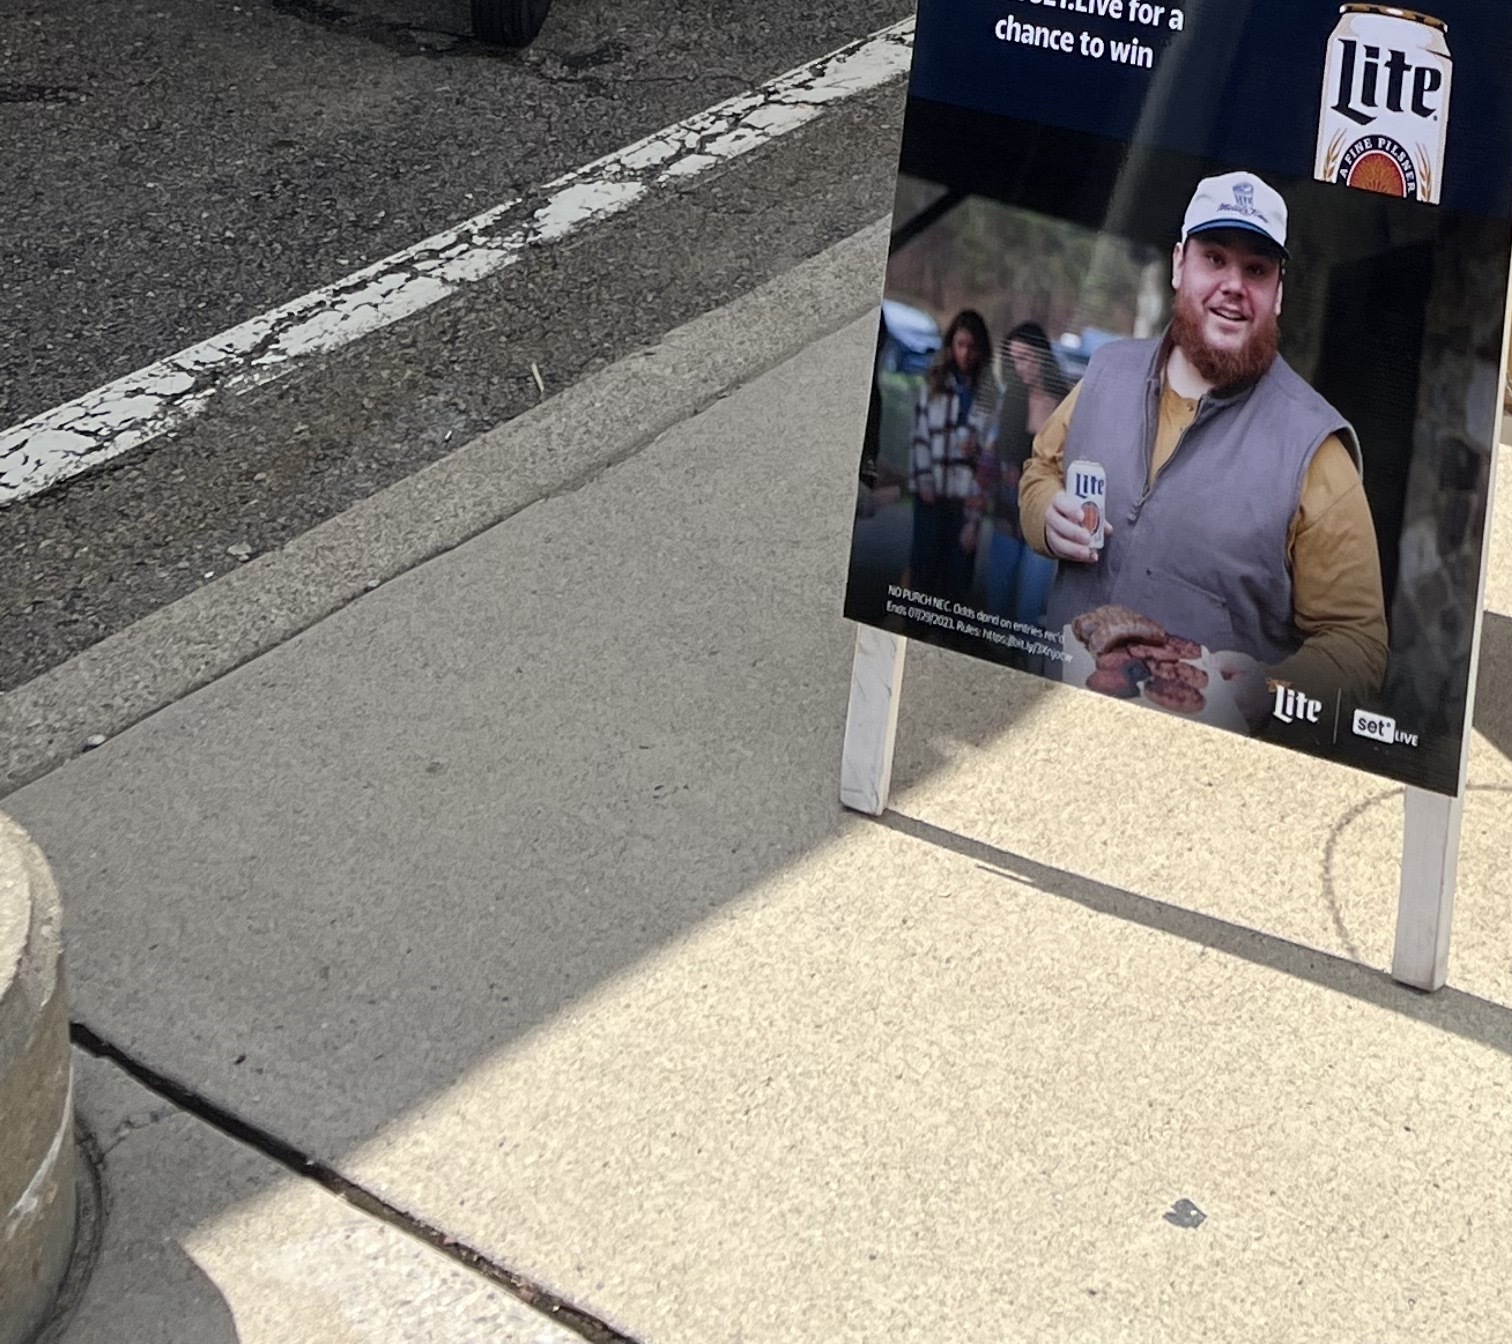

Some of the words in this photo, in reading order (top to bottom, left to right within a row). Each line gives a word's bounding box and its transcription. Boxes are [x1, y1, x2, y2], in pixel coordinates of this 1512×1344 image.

[1168, 9, 1184, 31] a
[995, 14, 1074, 53] chance
[1079, 31, 1105, 58] to
[1110, 38, 1154, 69] win
[1331, 38, 1443, 126] Lite
[1339, 168, 1348, 179] A
[1344, 137, 1373, 164] FINE
[1377, 137, 1416, 194] PILSNER
[1075, 472, 1105, 499] Lite
[888, 584, 902, 598] NO
[1272, 684, 1323, 724] Lite
[1394, 729, 1419, 747] LIVE
